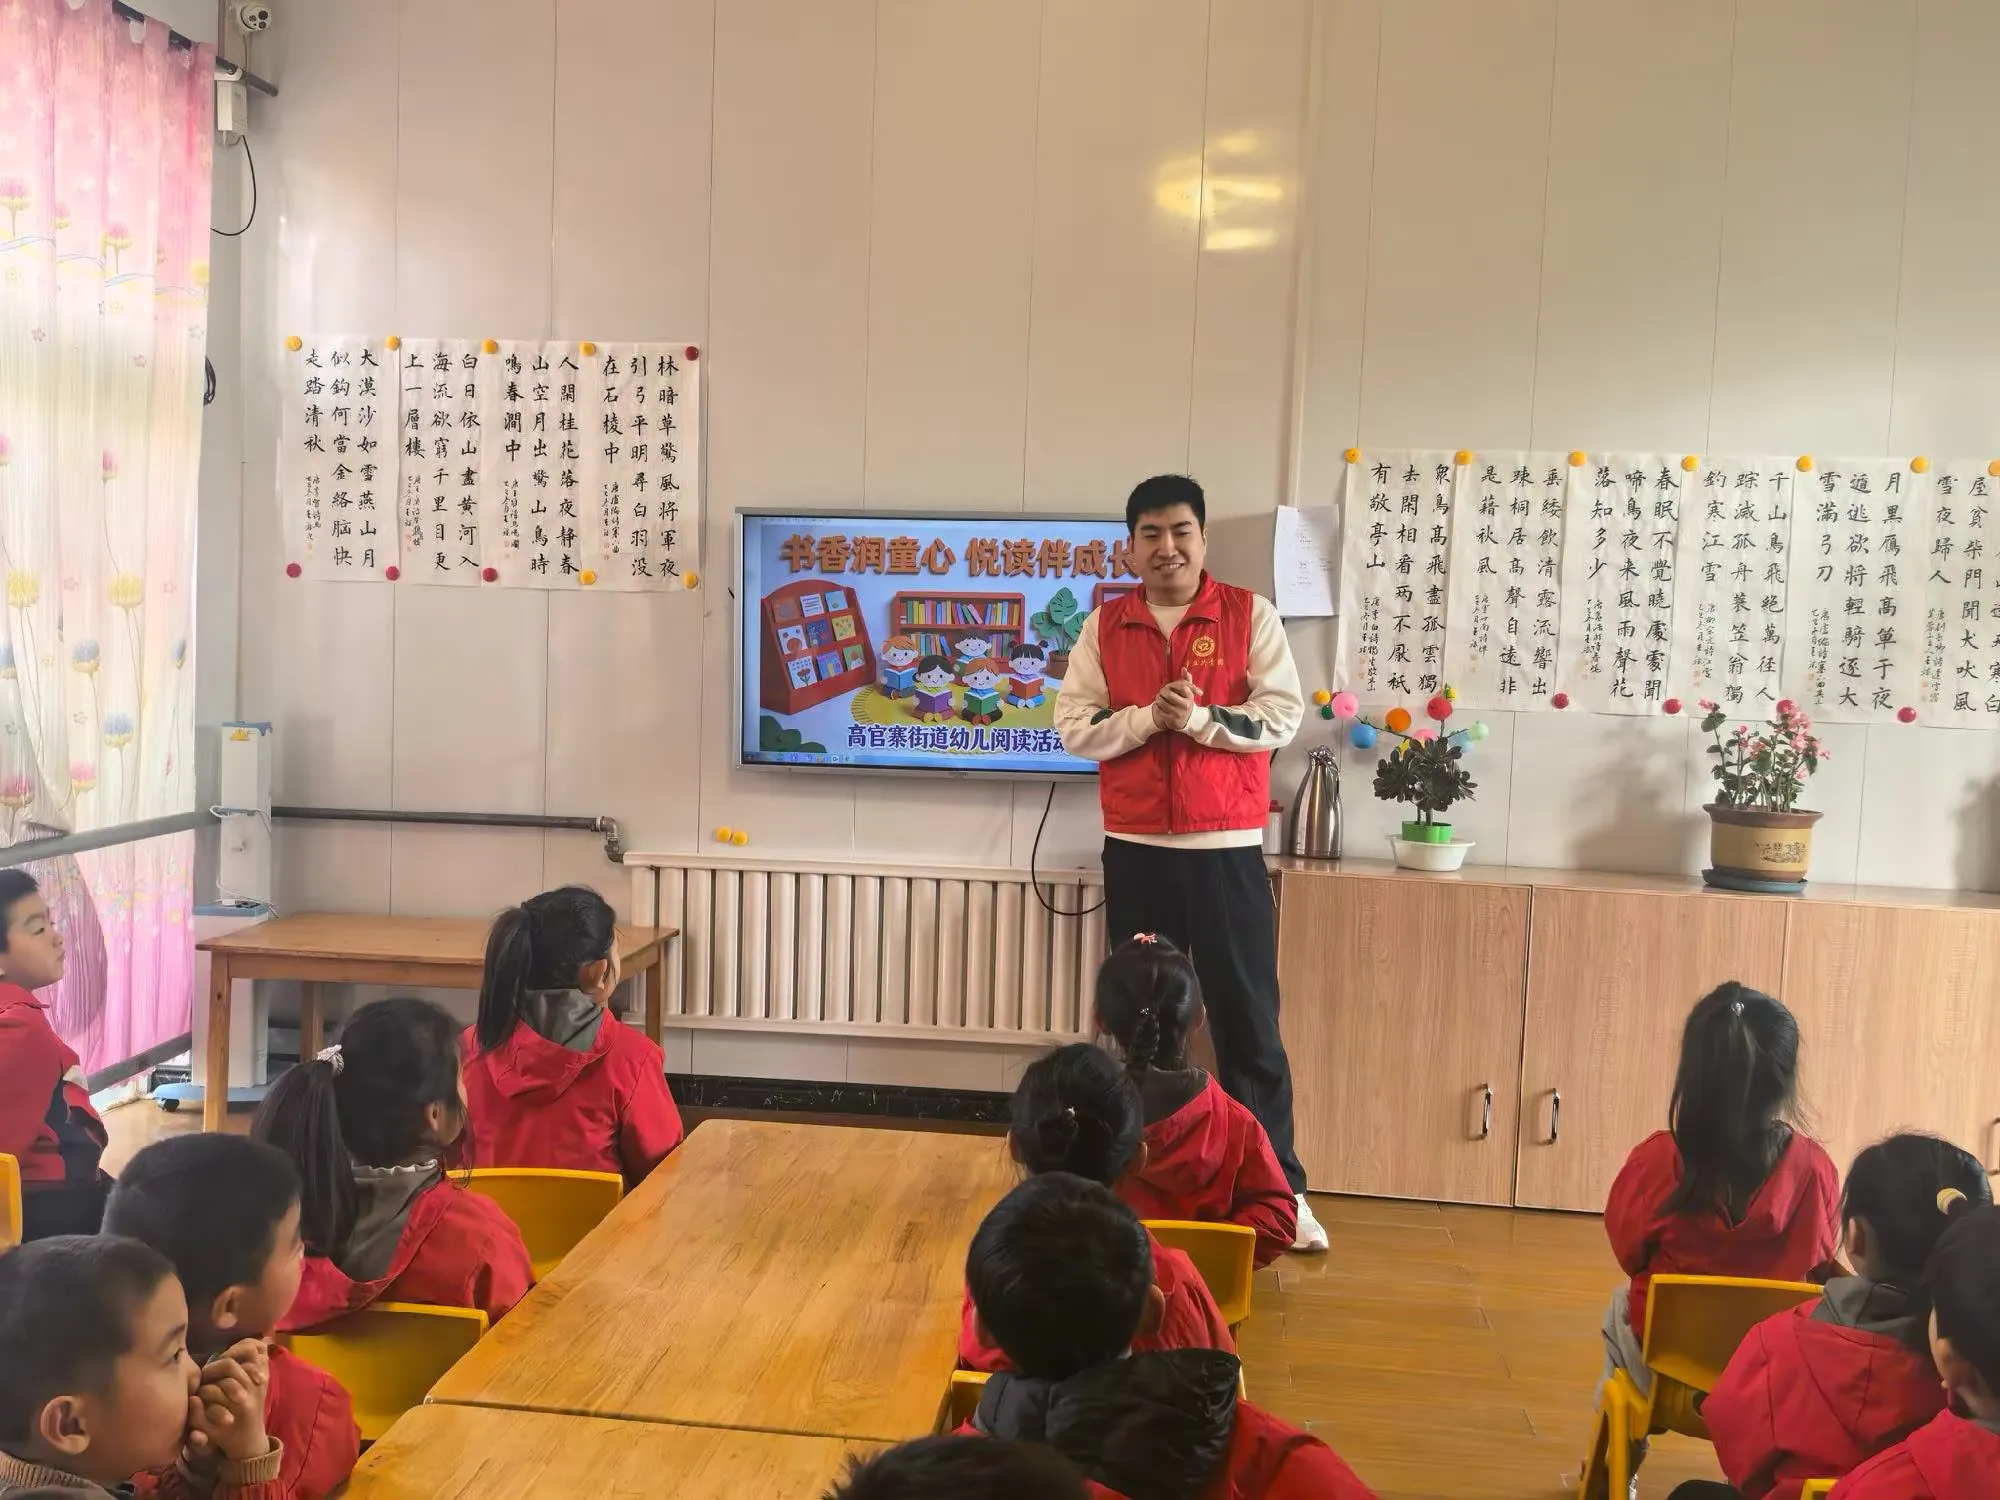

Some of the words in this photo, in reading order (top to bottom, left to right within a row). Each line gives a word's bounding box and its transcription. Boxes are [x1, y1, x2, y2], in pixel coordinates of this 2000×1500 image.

[357, 348, 379, 568] 大漠沙如雪燕山月
[403, 353, 425, 459] 上一層樓
[431, 352, 453, 571] 海流欲窮千里目更
[503, 353, 525, 463] 鳴春澗中
[602, 355, 624, 464] 在石棱中
[531, 356, 550, 575] 山空月出驚山鳥時
[657, 355, 680, 577] 林暗草驚風將軍夜
[1366, 463, 1393, 571] 有敬亭山
[1475, 465, 1503, 575] 是藉秋風
[780, 533, 956, 576] 书香润童心
[1587, 466, 1617, 580] 落知多少
[1700, 471, 1727, 582] 釣寒江雪
[1927, 475, 1958, 584] 雪夜歸人
[1838, 473, 1872, 706] 遁逃欲將輕騎逐大
[1953, 475, 1989, 712] 屋貧柴門聞犬吠風
